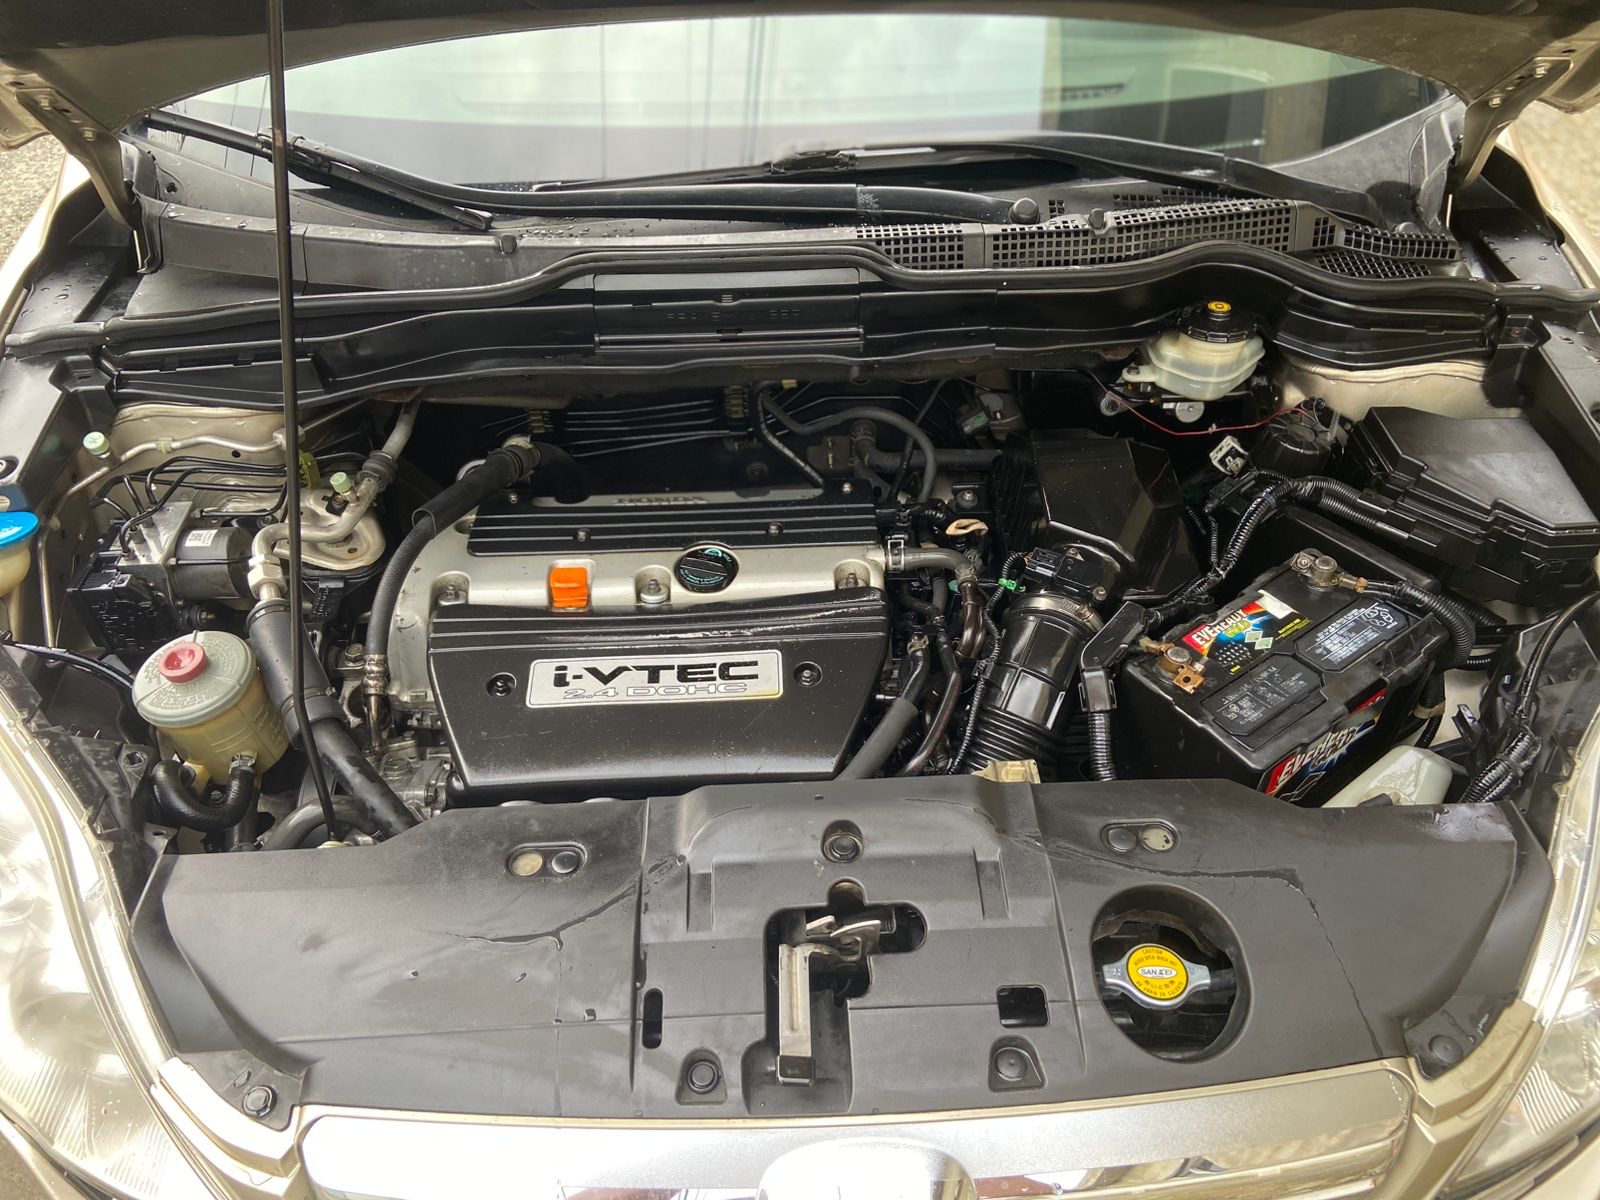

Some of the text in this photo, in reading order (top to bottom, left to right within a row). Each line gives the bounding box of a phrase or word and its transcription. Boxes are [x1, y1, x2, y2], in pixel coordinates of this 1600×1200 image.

[612, 496, 707, 506] HONDA
[553, 660, 759, 688] i-VTEC
[563, 683, 747, 699] 2.4 DOHC
